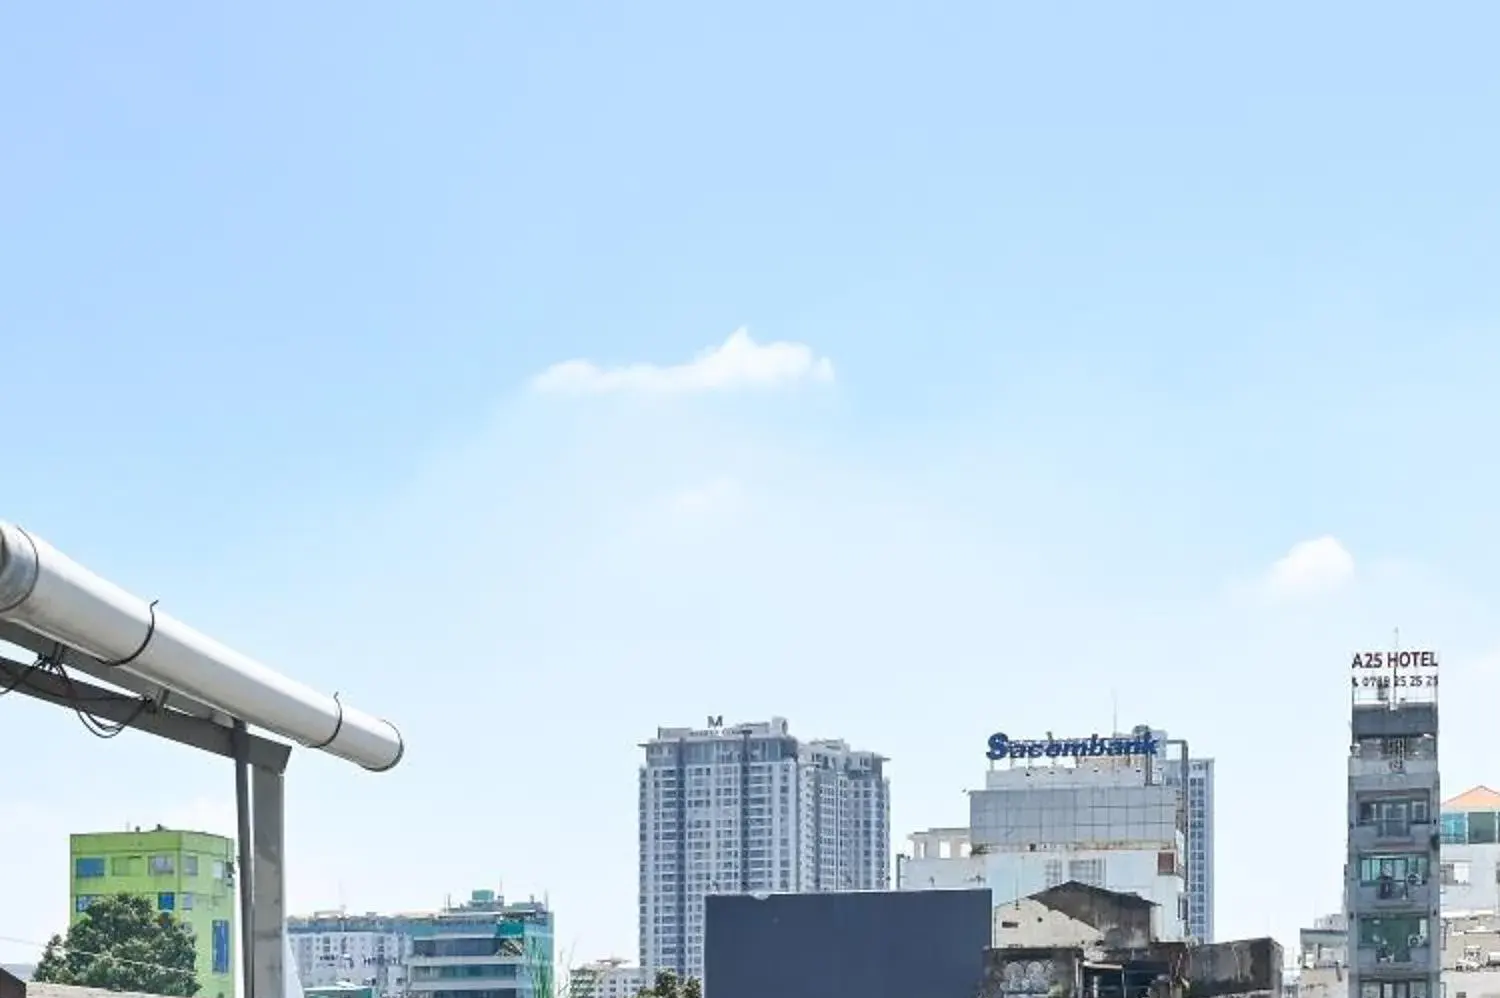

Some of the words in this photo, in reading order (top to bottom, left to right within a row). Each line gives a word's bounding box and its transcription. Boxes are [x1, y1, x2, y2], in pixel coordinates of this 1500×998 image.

[1352, 653, 1383, 668] A25
[1387, 651, 1438, 668] HOTEL
[986, 731, 1158, 760] Sacombank
